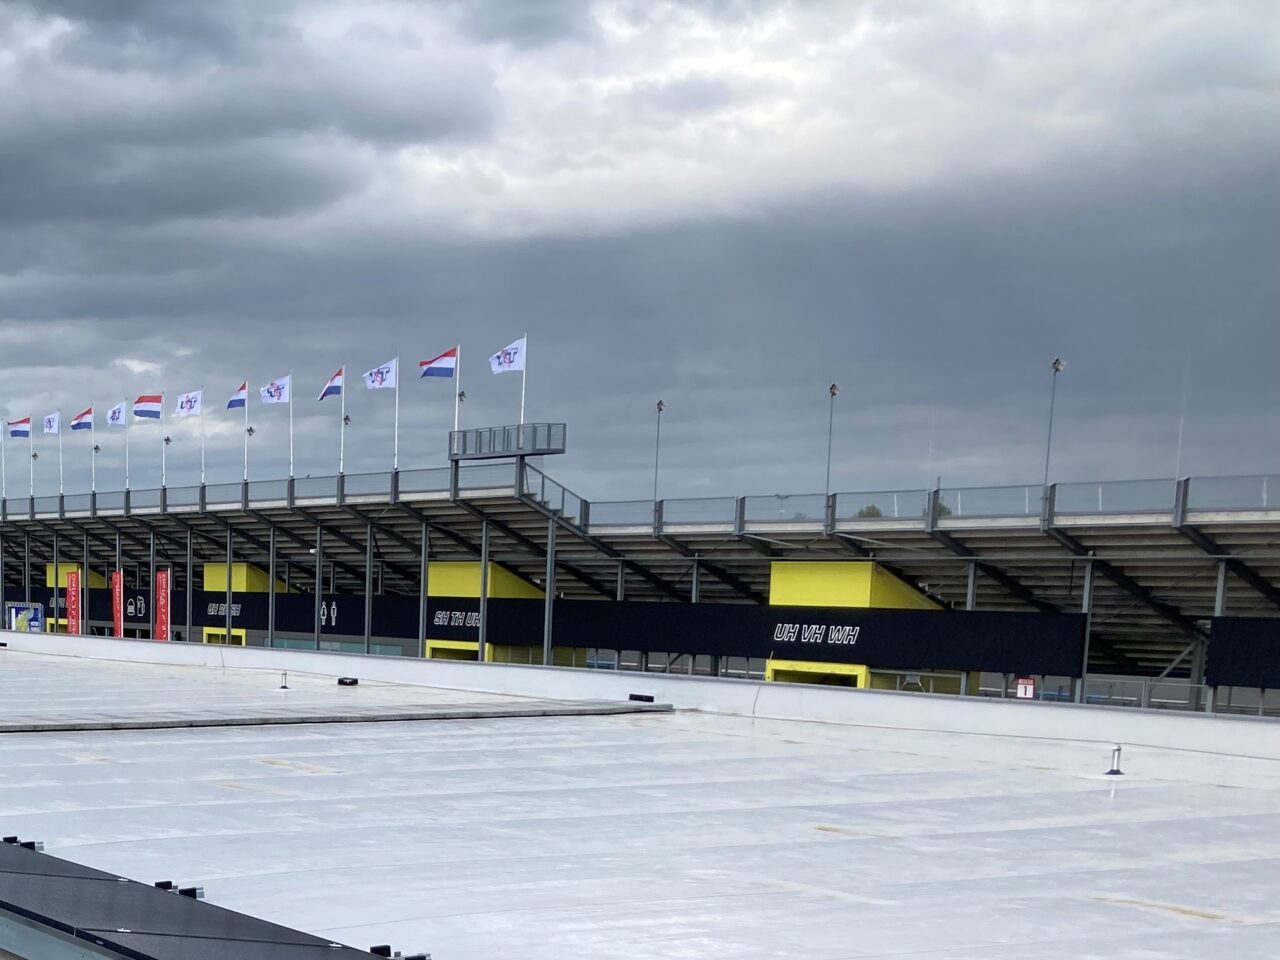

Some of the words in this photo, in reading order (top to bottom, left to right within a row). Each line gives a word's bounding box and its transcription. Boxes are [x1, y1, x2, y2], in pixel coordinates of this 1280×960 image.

[434, 611, 450, 625] SH
[451, 612, 465, 626] TH
[466, 612, 480, 627] UH
[773, 623, 799, 642] UH
[801, 624, 826, 643] VH
[828, 625, 860, 645] WH
